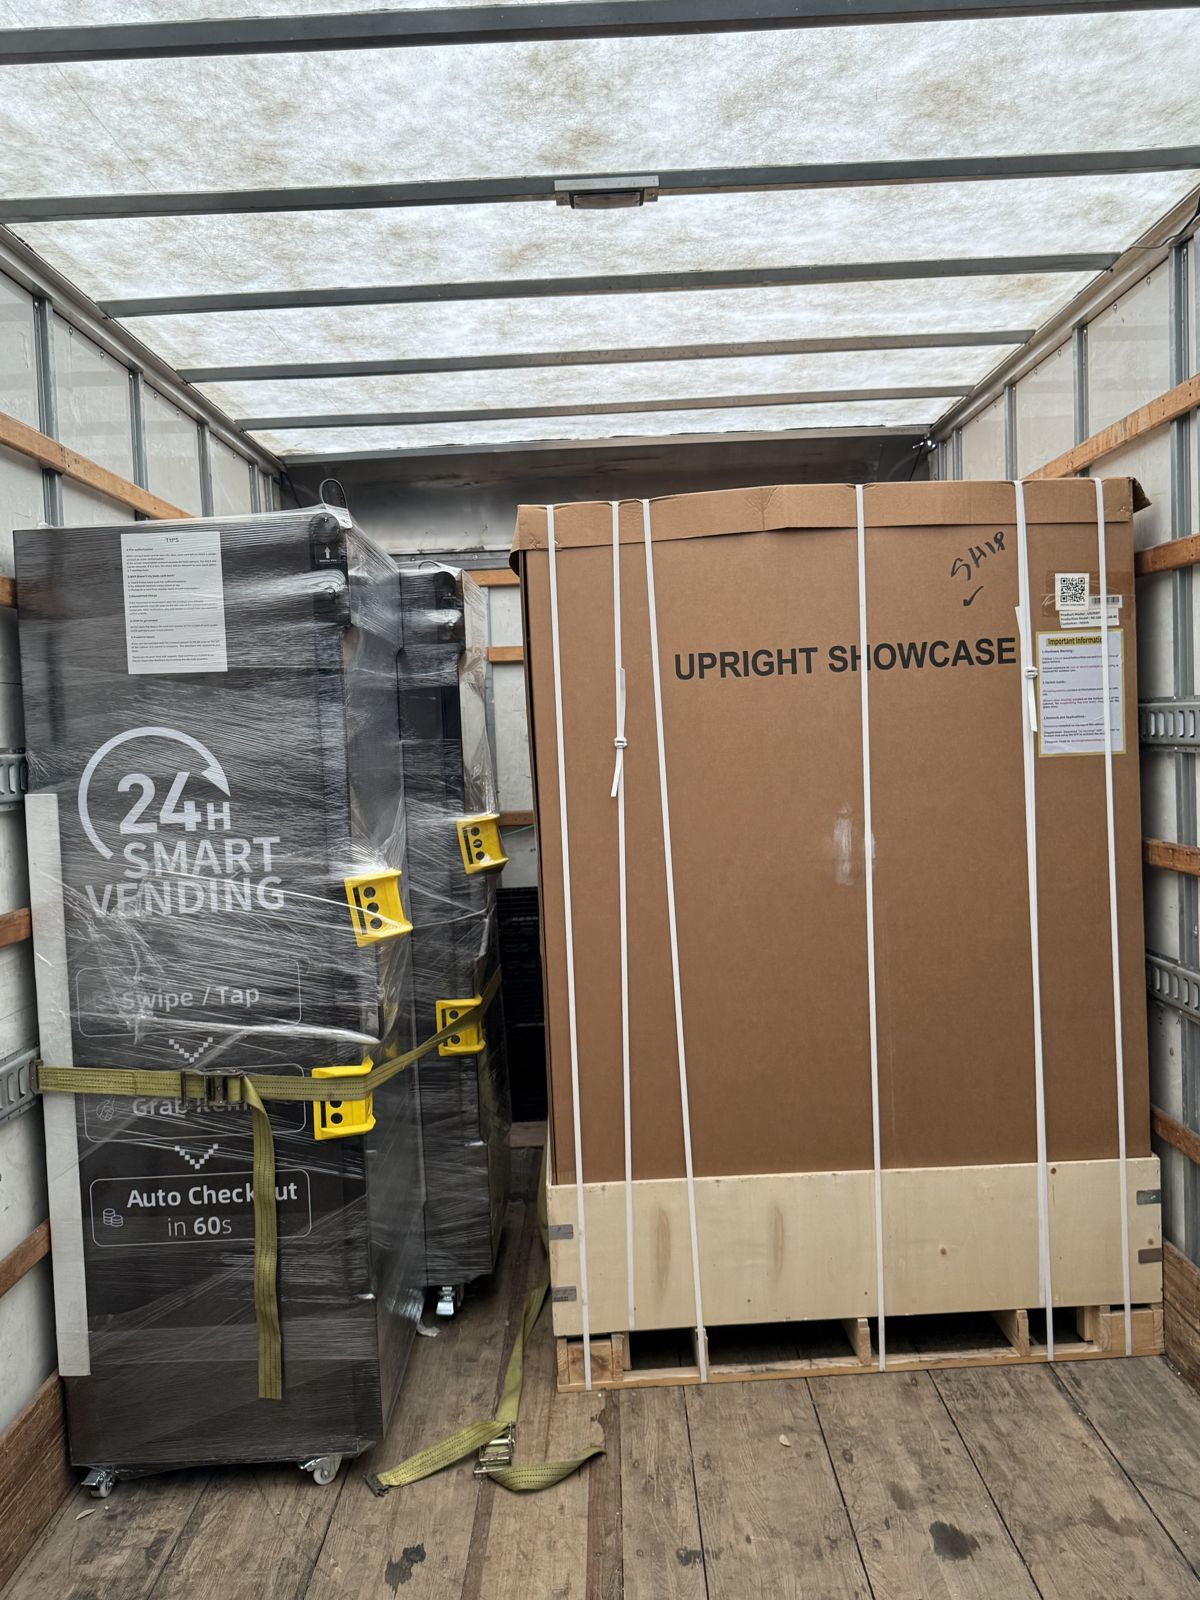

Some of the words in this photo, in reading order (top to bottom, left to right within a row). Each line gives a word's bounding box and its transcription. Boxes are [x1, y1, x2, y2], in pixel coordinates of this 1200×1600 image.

[1047, 637, 1075, 646] Important
[674, 647, 818, 680] UPRIGHT
[828, 637, 1017, 673] SHOWCASE
[117, 772, 232, 834] 24H
[123, 836, 281, 879] SMART
[85, 875, 285, 918] VENDING
[122, 989, 194, 1012] Swipe
[215, 986, 260, 1007] Tap
[132, 1098, 188, 1117] Grab
[127, 1188, 182, 1208] Auto
[188, 1182, 298, 1206] Checkut
[167, 1217, 187, 1237] in
[193, 1216, 232, 1236] 60s
